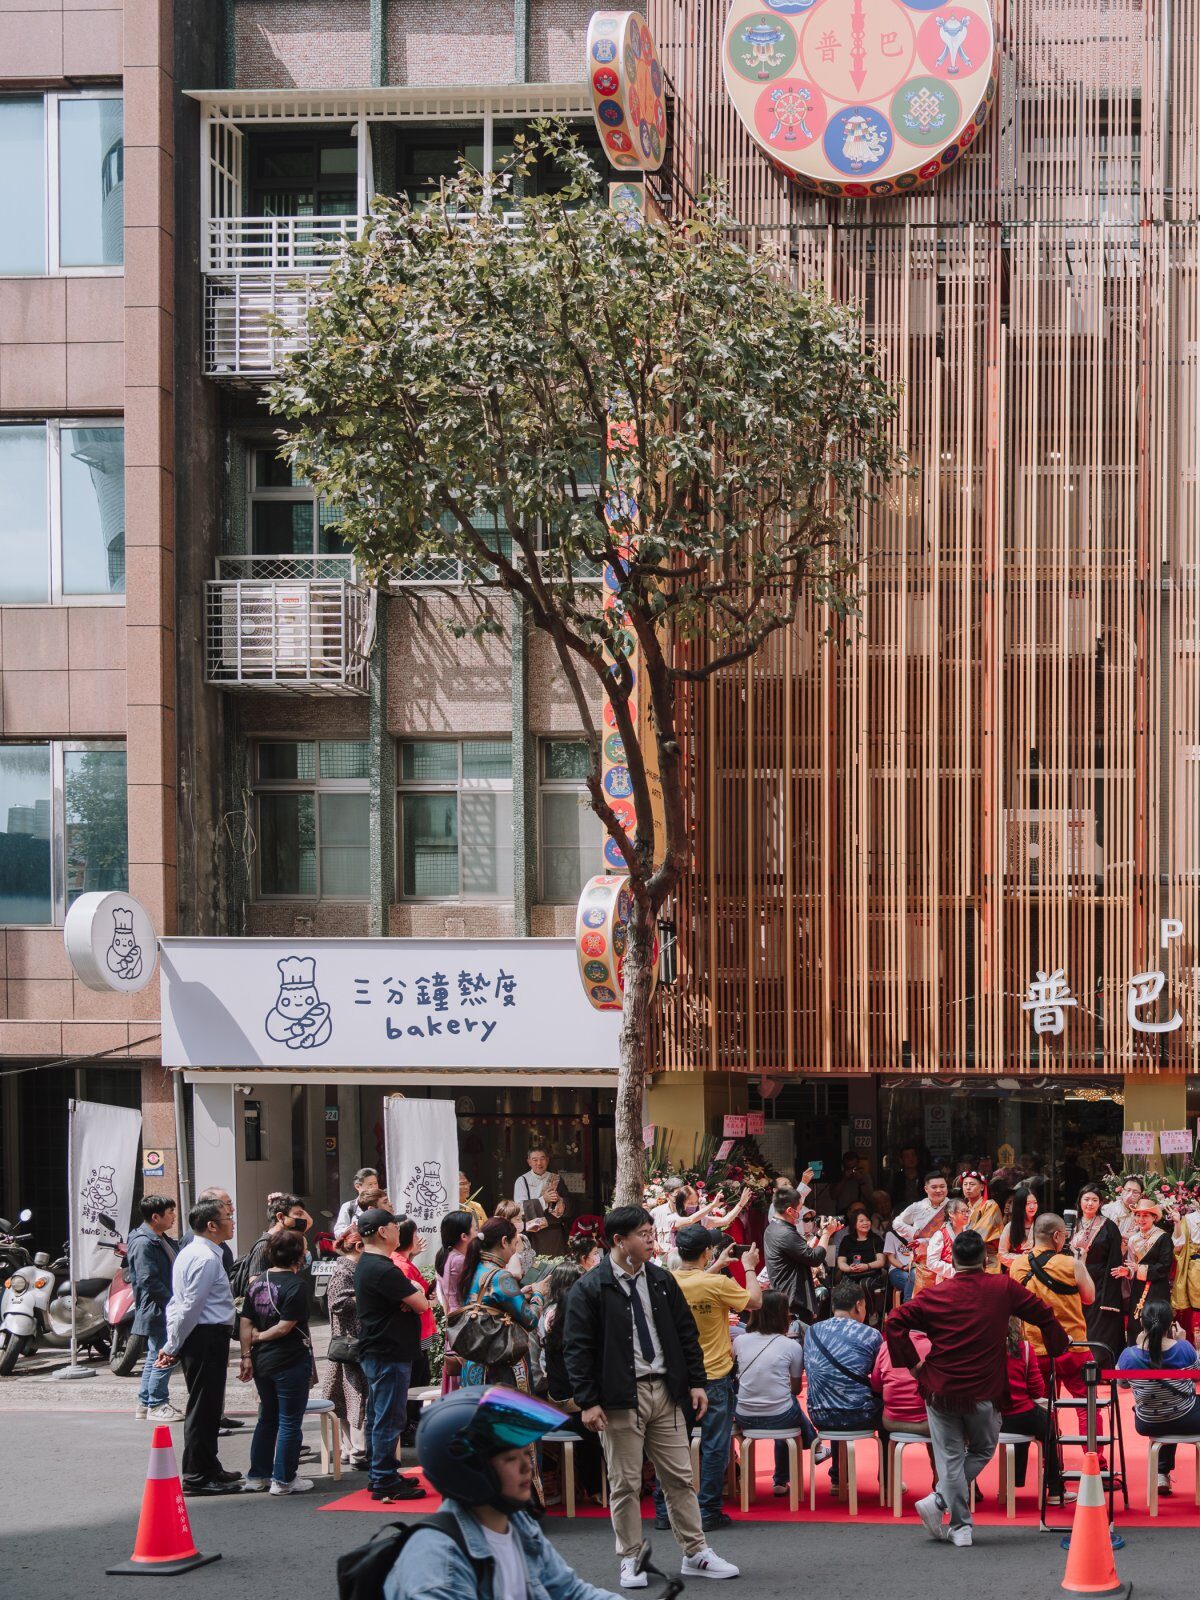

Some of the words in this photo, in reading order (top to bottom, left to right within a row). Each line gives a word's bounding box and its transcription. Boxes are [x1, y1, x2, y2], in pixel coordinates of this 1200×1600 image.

[815, 30, 843, 63] 普
[880, 31, 904, 57] 巴
[354, 969, 517, 1011] 三分鐘熱度
[386, 1015, 497, 1042] bakery
[856, 1120, 870, 1129] 218
